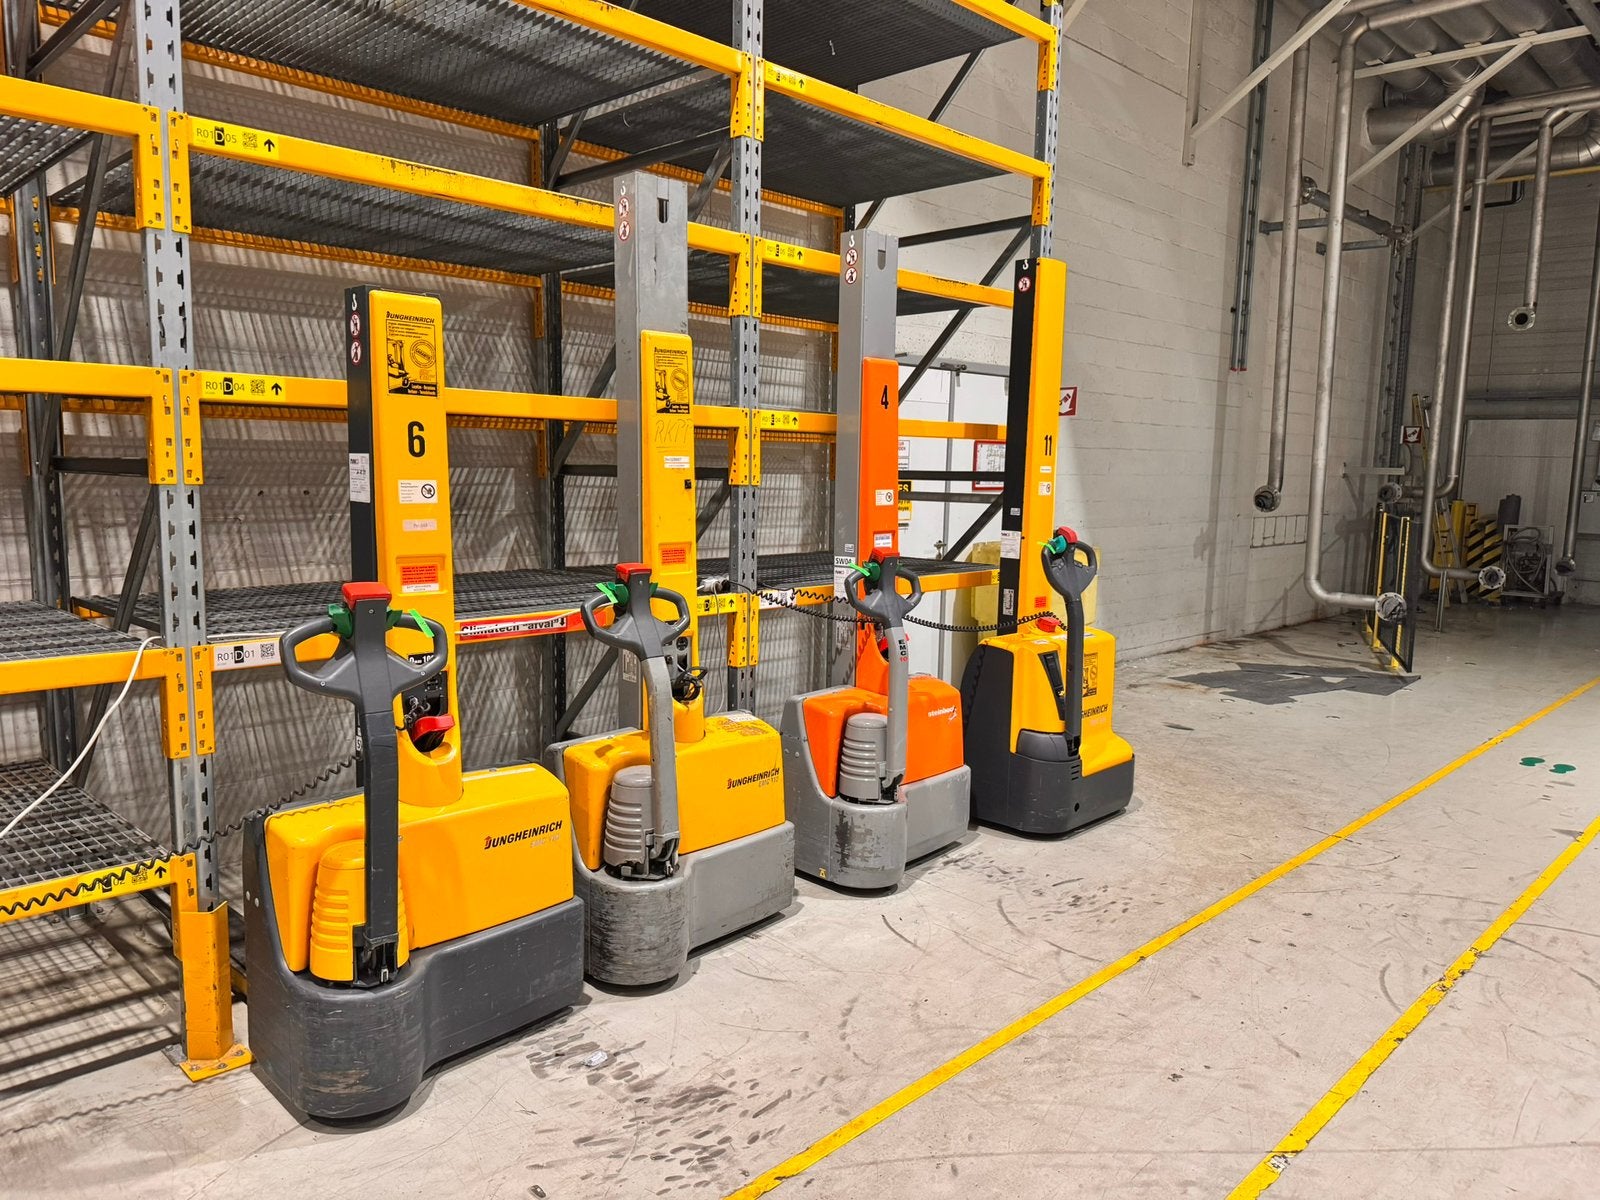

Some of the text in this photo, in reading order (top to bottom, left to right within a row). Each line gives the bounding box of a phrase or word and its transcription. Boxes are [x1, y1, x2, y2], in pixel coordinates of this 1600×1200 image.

[386, 310, 434, 324] JUNGHEINRICH
[881, 385, 889, 409] 4
[408, 421, 425, 457] 6
[1044, 435, 1053, 456] 11
[727, 768, 780, 789] JUNGHEINRICH
[484, 820, 563, 850] JUNGHEINRICH
